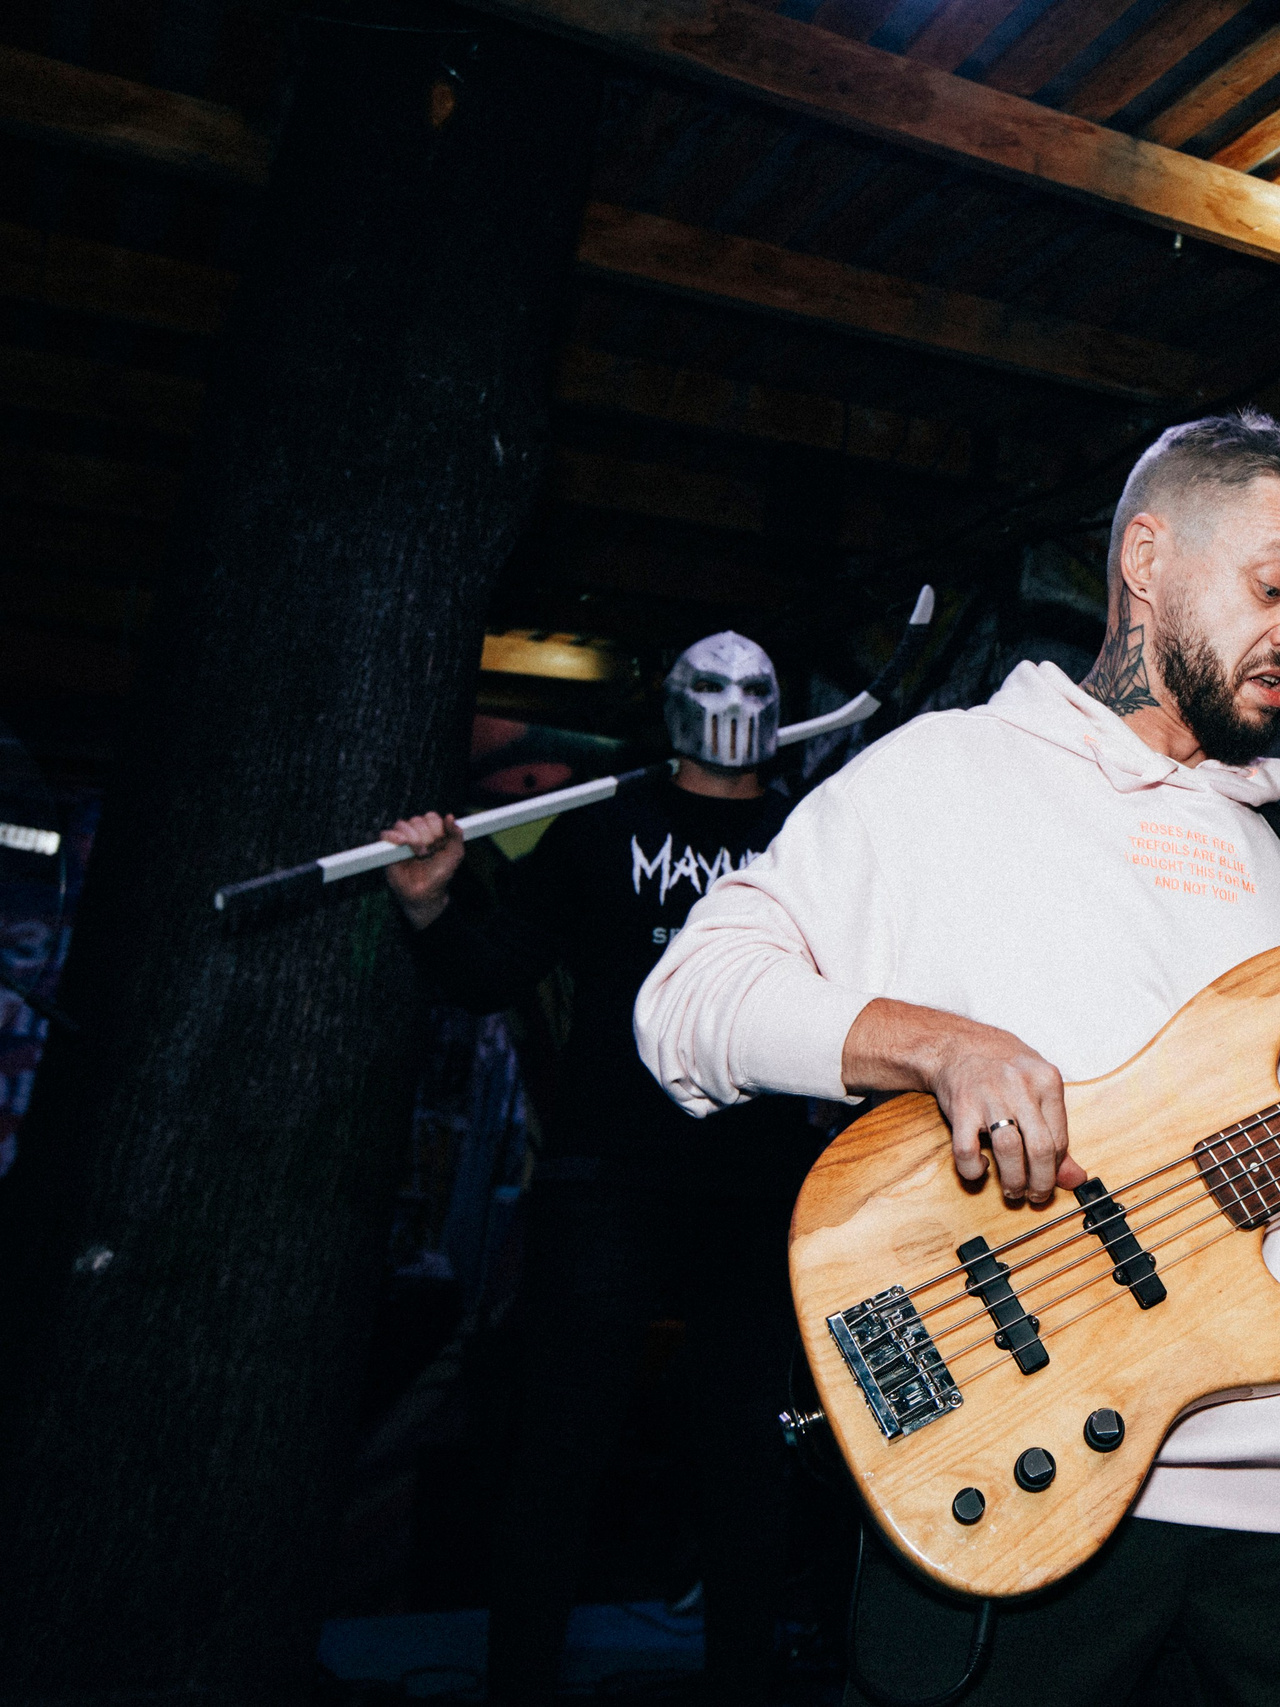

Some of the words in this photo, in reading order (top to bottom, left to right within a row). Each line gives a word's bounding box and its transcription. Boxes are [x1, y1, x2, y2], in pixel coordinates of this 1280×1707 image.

[1139, 820, 1184, 839] ROSES
[1186, 829, 1209, 846] ARE
[1128, 835, 1190, 857] TREFOILS
[1193, 847, 1216, 863] ARE
[1132, 853, 1184, 873] BOUGHT
[1188, 862, 1215, 879] THIS
[1218, 870, 1240, 888] FOR
[1242, 878, 1257, 895] ME
[1155, 875, 1180, 891] AND
[1183, 880, 1208, 897] NOT
